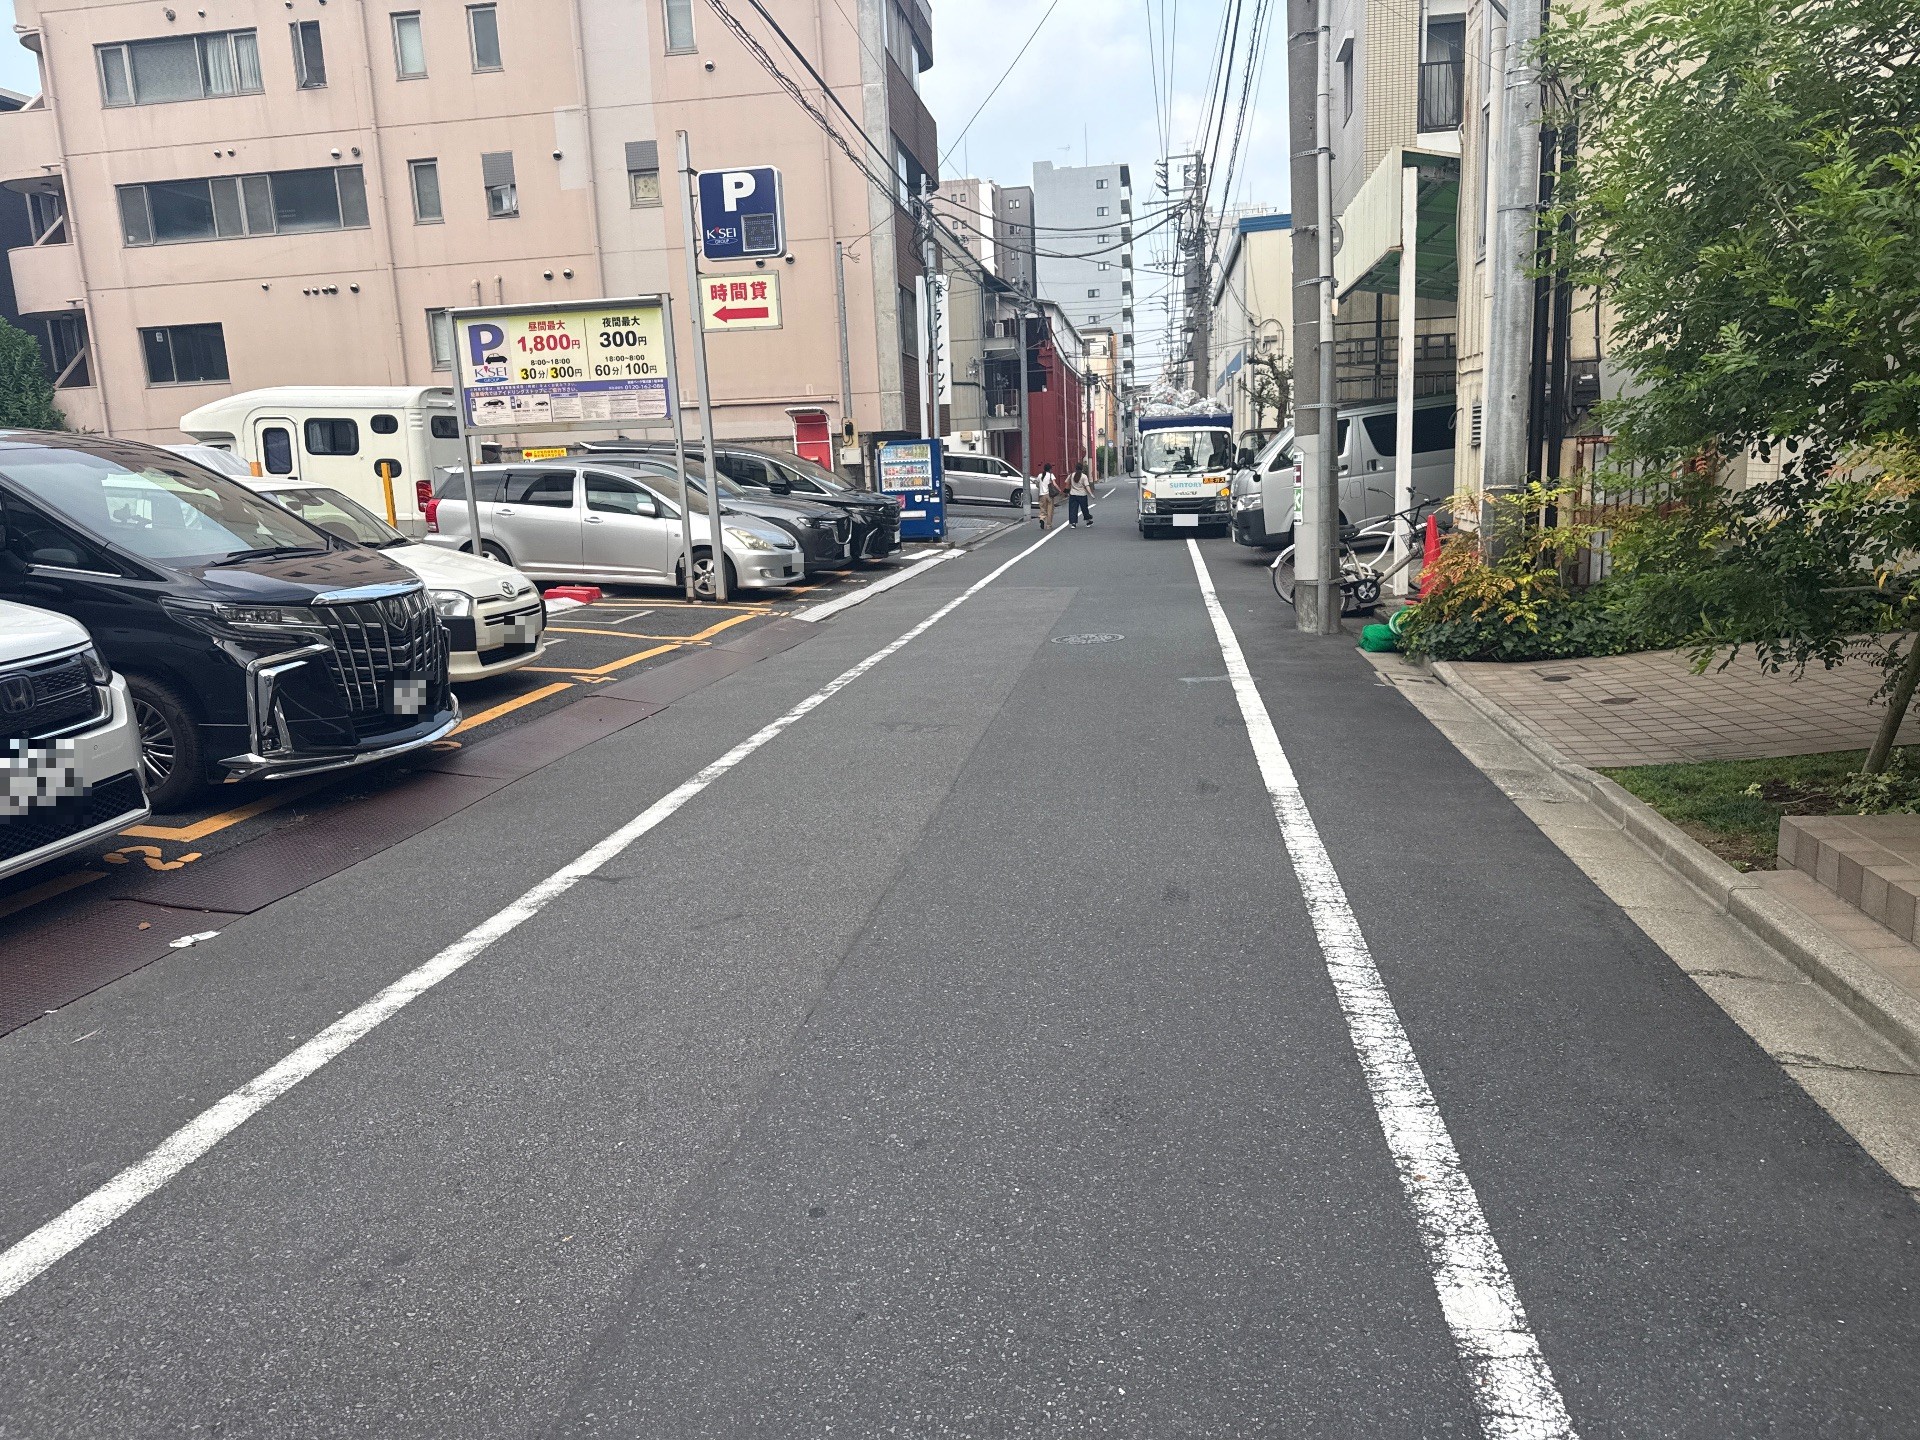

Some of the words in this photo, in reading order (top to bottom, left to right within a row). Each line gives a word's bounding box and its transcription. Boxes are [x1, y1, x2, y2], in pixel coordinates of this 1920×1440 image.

[722, 172, 755, 212] P
[710, 281, 767, 302] 時間貸
[528, 320, 566, 332] 昼間最大
[602, 316, 640, 328] 夜間最大
[467, 323, 505, 366] P
[517, 333, 581, 354] 1,800円
[599, 330, 647, 348] 300円
